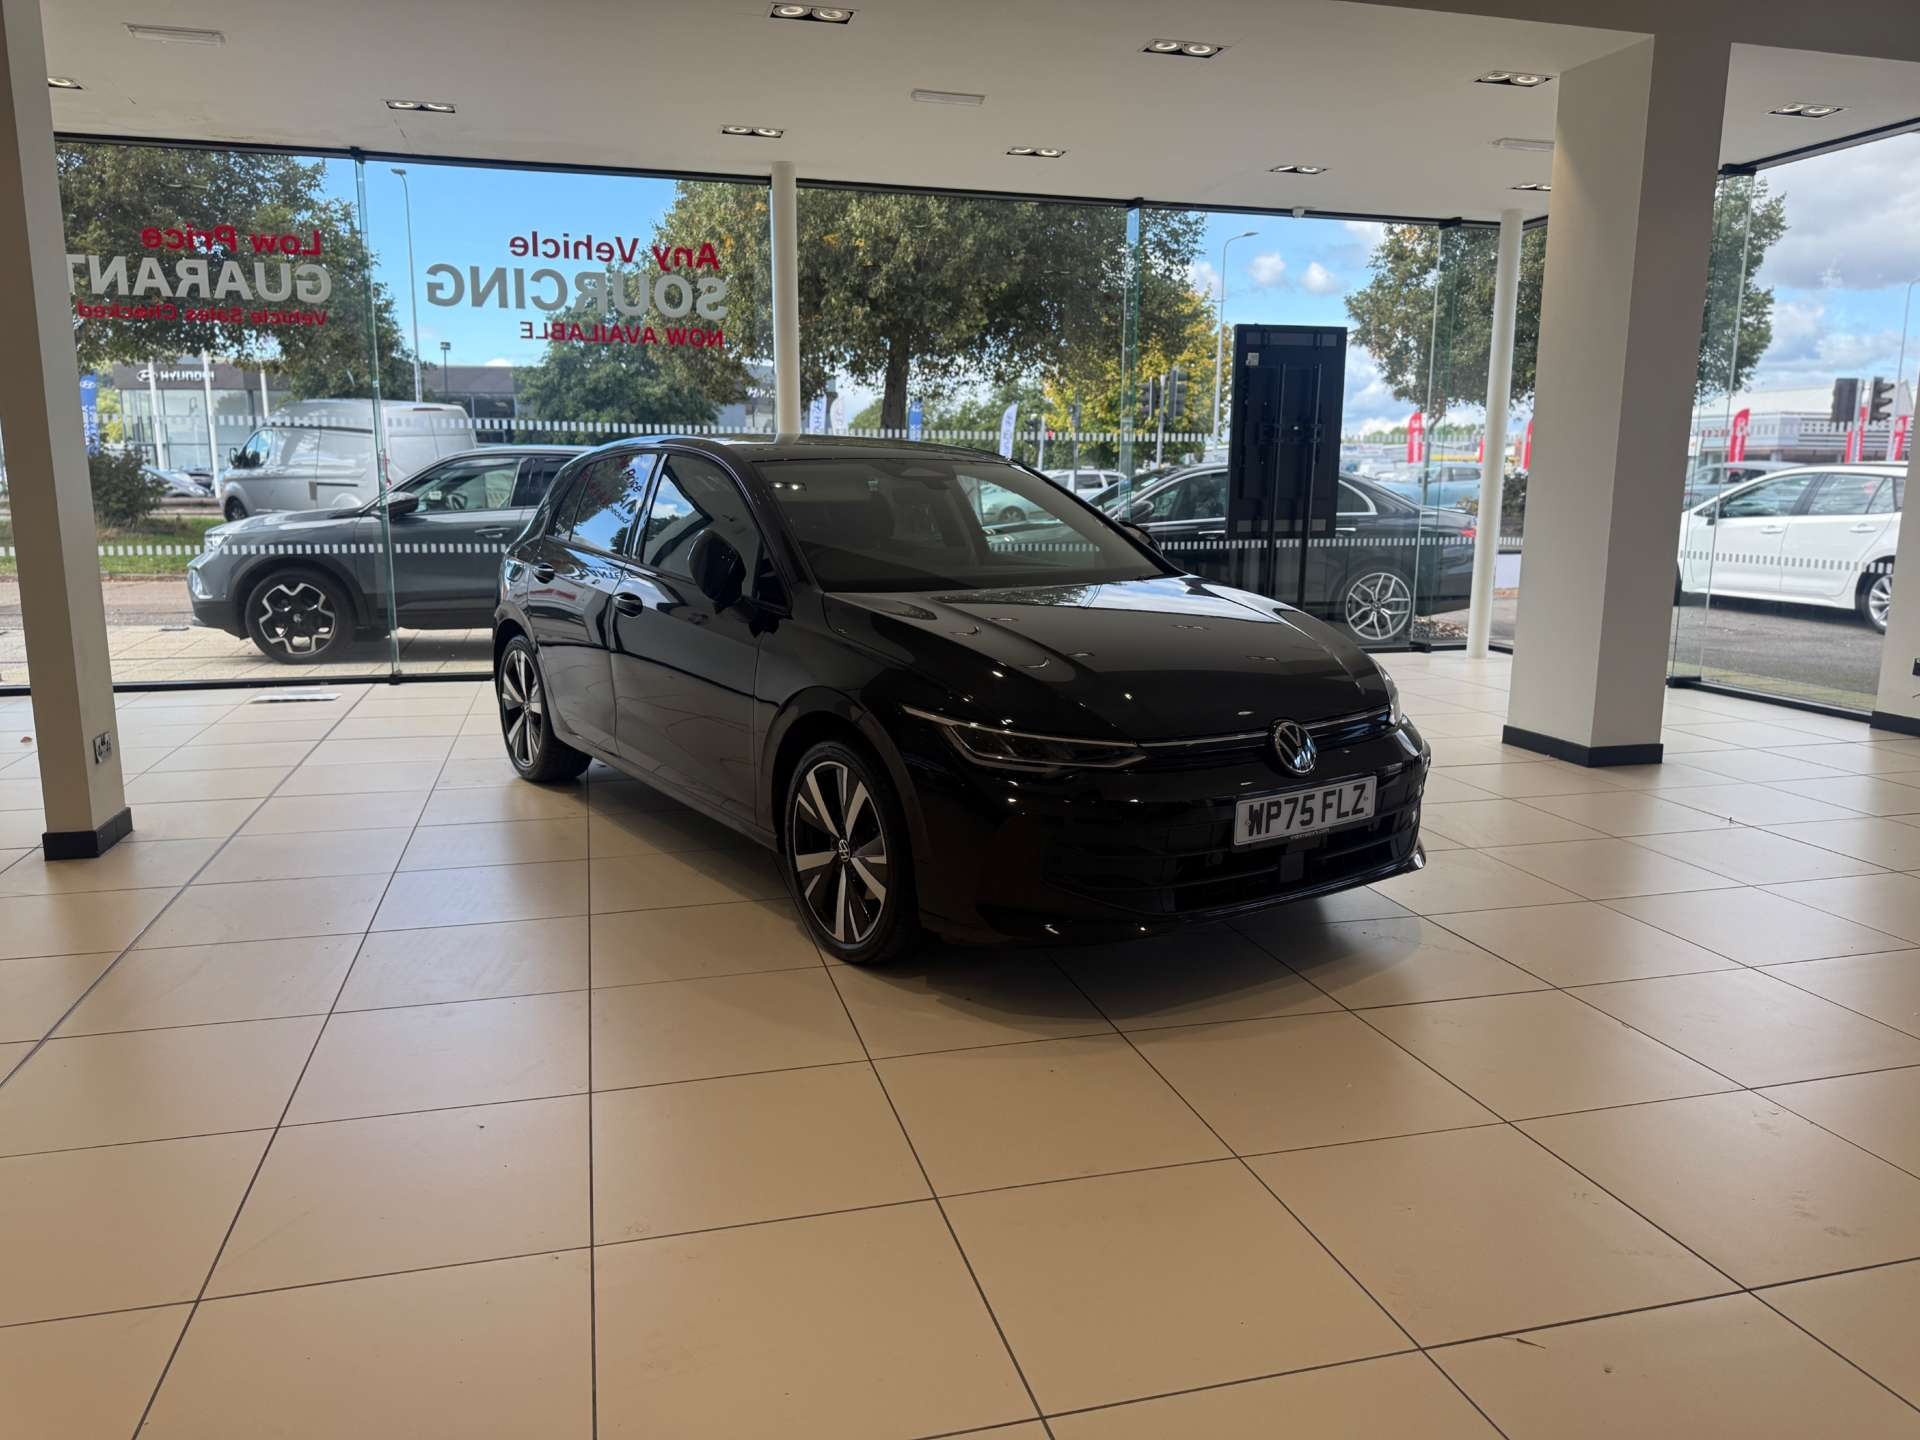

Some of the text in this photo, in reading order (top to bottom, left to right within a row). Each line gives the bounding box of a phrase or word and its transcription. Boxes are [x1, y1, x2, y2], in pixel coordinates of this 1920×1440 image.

[160, 370, 214, 381] HYUNDI
[1248, 783, 1367, 837] WP75 FLZ
